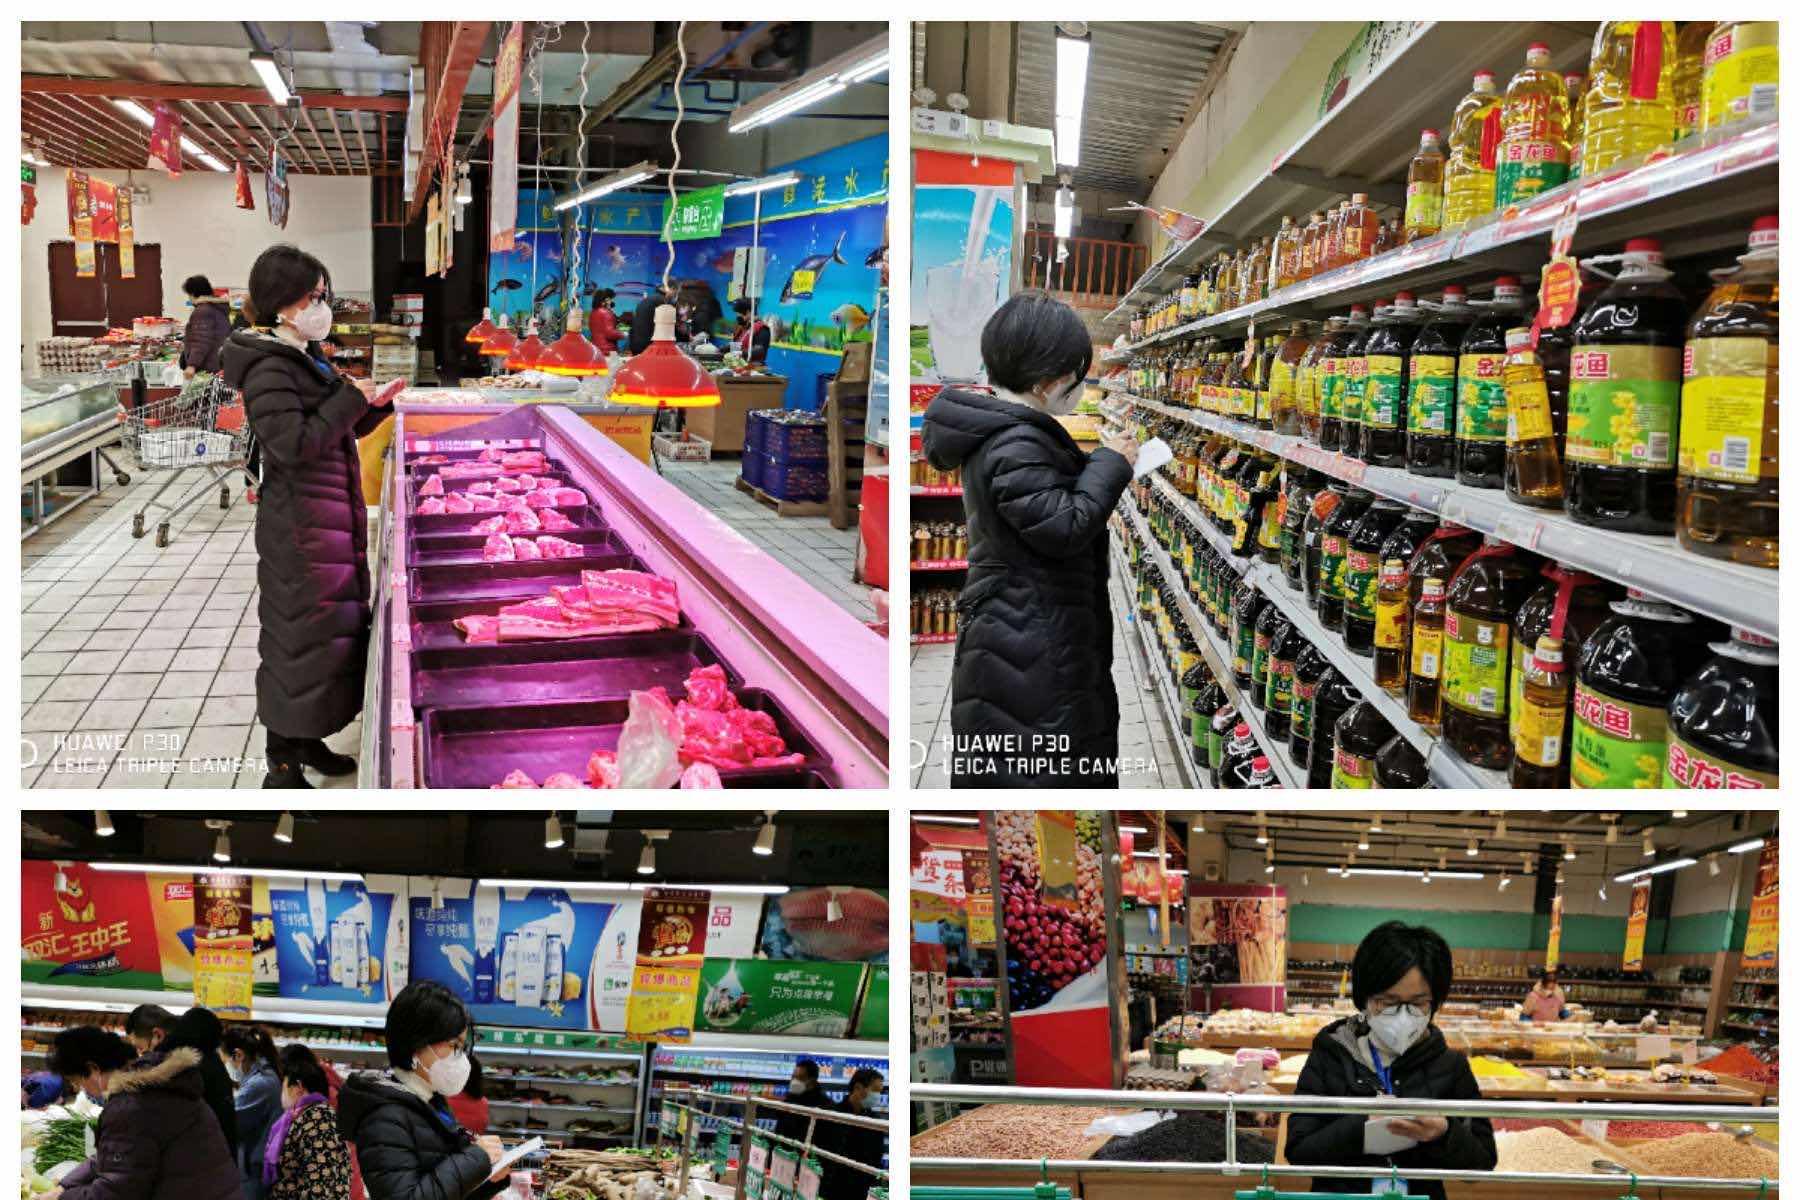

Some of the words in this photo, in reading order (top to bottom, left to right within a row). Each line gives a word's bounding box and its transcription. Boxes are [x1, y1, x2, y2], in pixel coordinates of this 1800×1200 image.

[1509, 143, 1557, 161] 金龙鱼
[38, 911, 54, 930] 新
